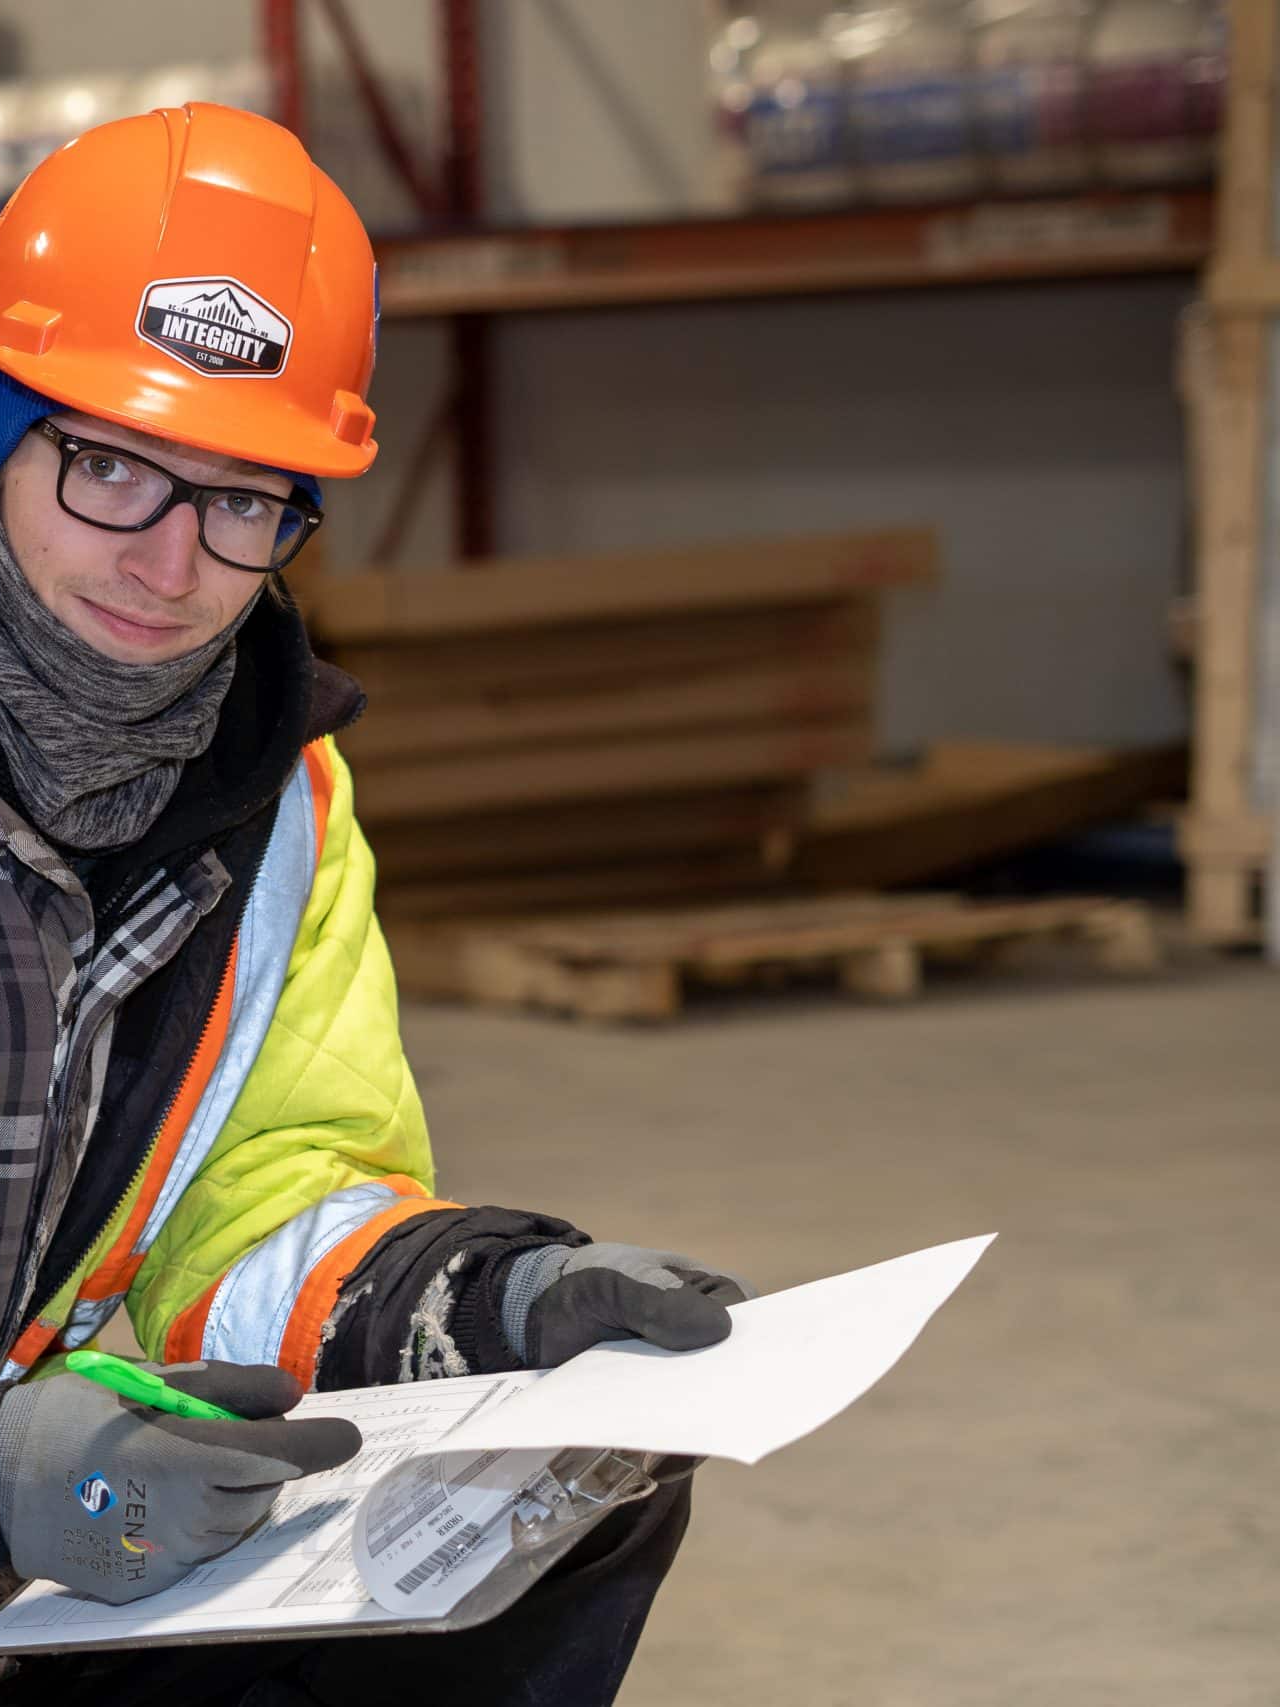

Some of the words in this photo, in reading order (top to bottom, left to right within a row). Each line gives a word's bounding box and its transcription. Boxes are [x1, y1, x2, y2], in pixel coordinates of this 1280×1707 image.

[161, 314, 266, 363] INTEGRITY
[196, 352, 208, 362] EST
[121, 1478, 152, 1582] ZENITH
[436, 1515, 463, 1538] ORDER
